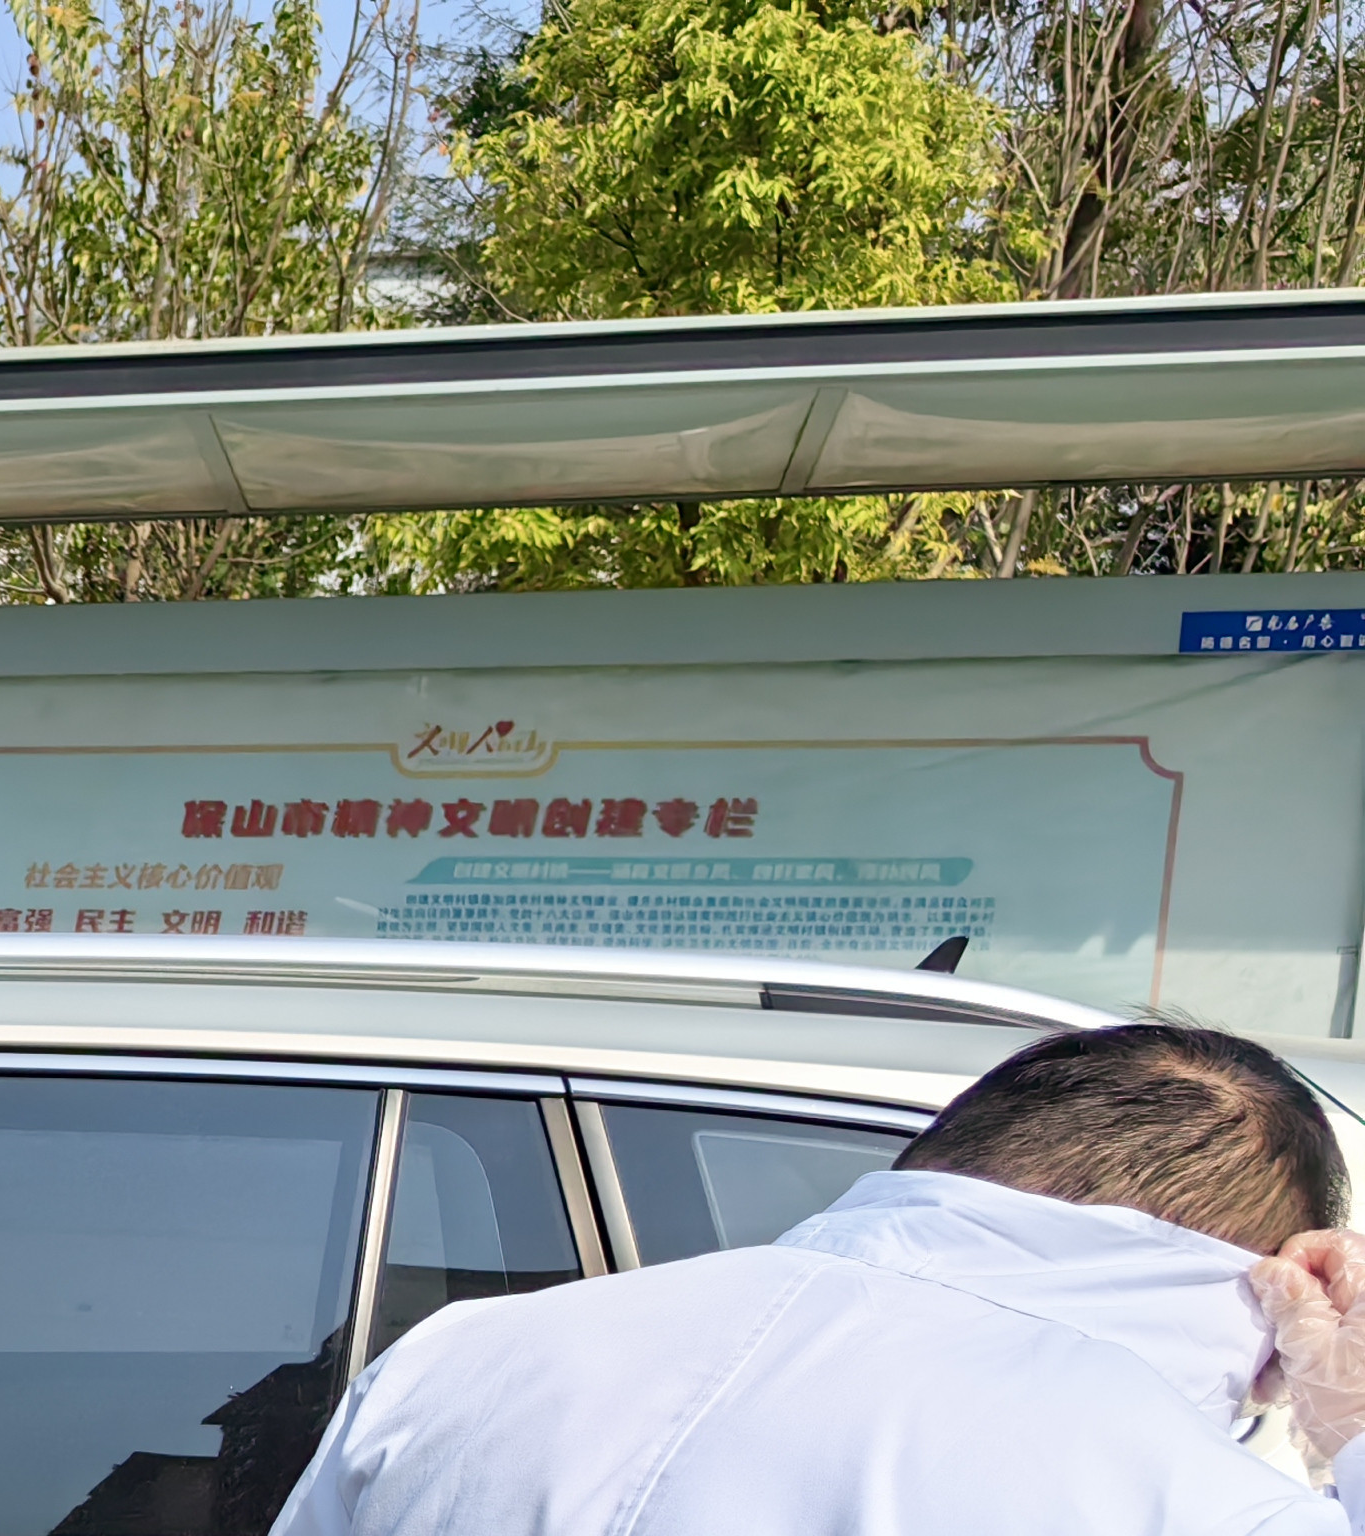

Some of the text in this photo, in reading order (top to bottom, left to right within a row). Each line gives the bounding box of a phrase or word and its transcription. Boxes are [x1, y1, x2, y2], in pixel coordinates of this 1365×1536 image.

[180, 798, 759, 838] 保山市精神文明创建专栏
[23, 862, 284, 890] 社会主义核心价值观
[74, 908, 137, 934] 民主
[160, 909, 223, 936] 文明
[243, 909, 309, 937] 和谐
